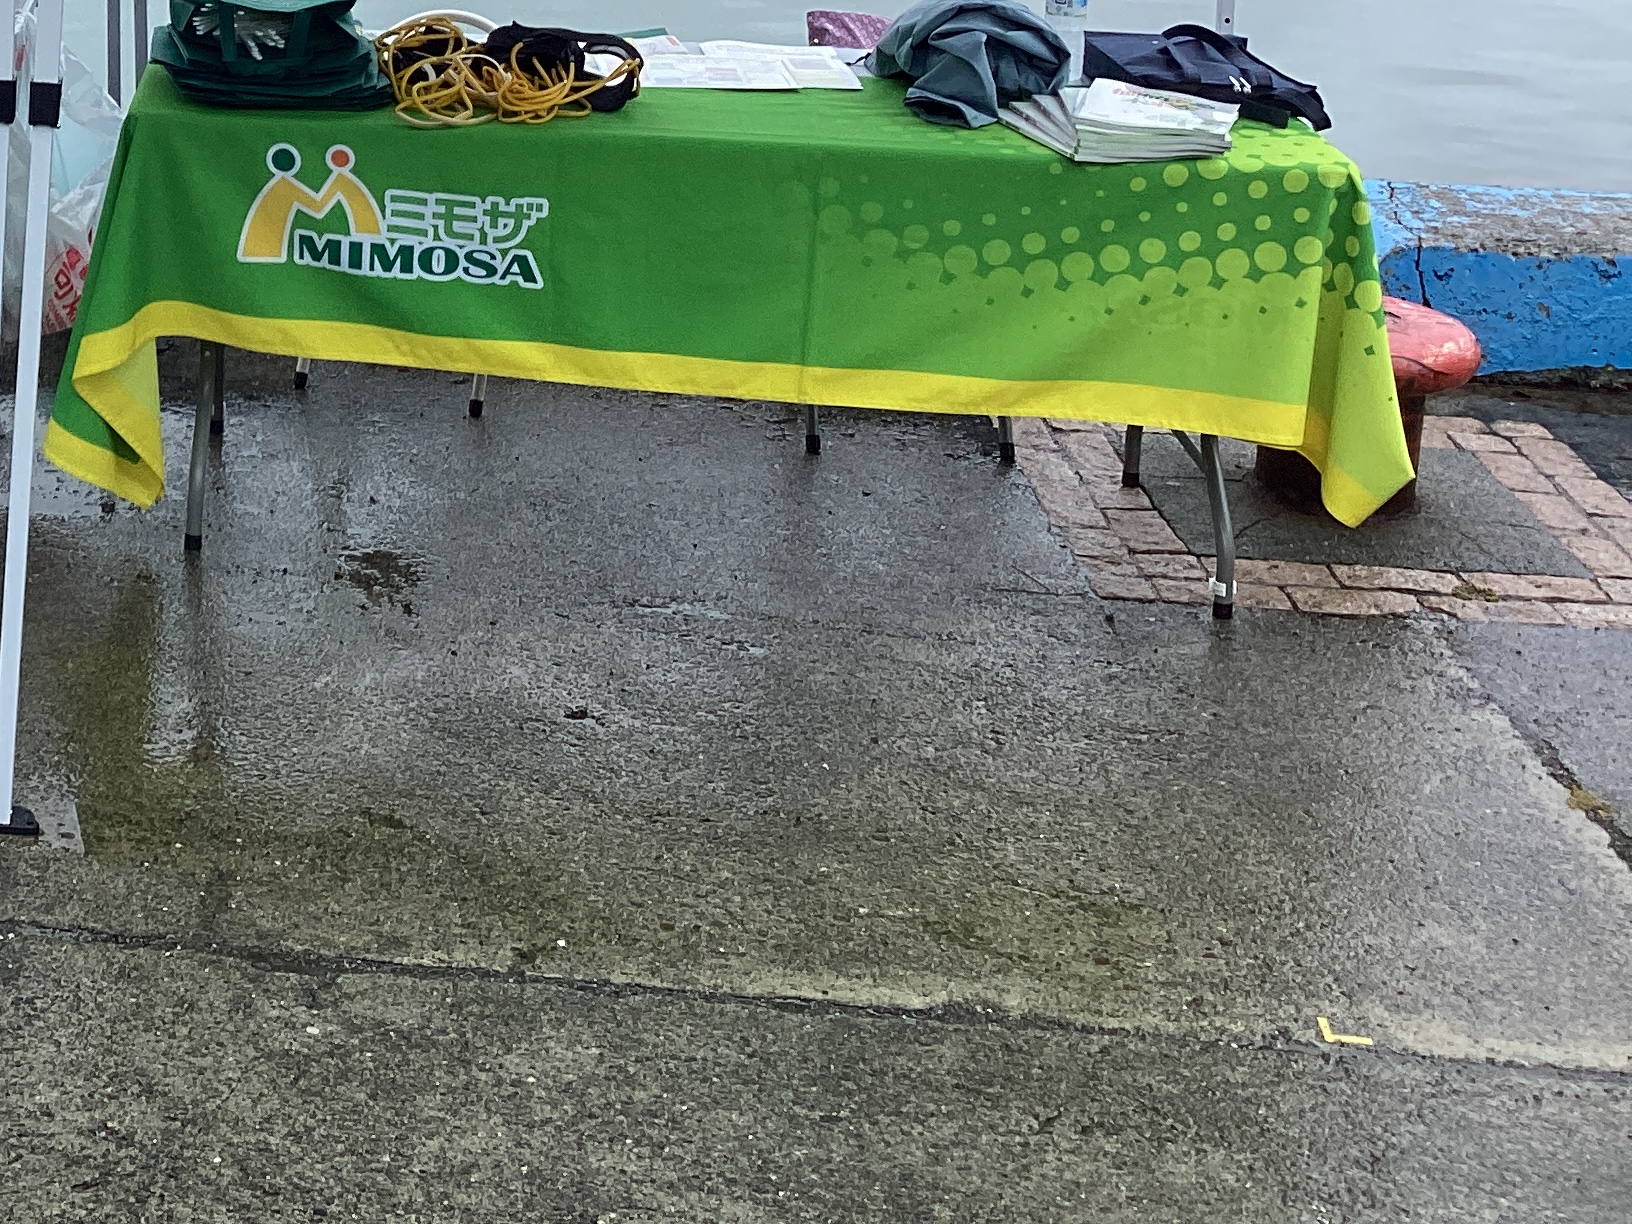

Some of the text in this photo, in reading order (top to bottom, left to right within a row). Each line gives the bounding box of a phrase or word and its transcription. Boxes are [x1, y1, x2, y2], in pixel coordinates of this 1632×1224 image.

[385, 190, 549, 249] ミモザ
[295, 231, 544, 289] MIMOSA
